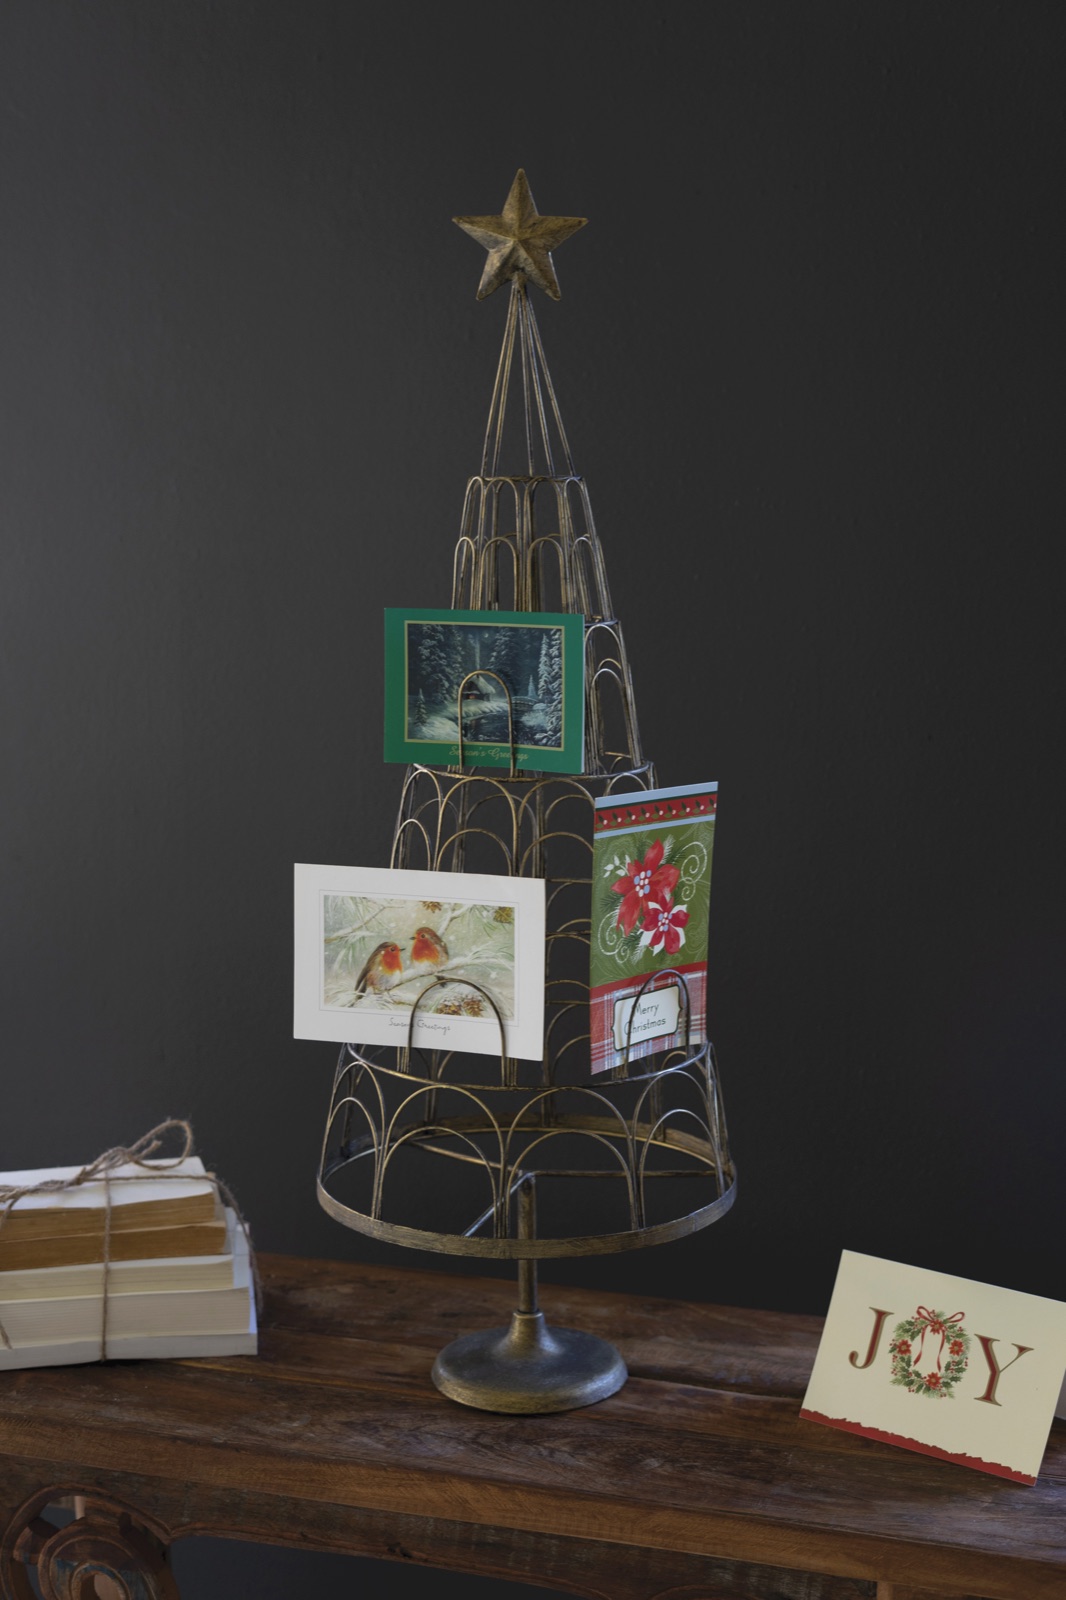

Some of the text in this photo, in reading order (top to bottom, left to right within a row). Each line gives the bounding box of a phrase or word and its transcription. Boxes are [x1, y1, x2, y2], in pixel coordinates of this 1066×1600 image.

[449, 745, 529, 761] Seson's Greengs
[848, 1305, 1035, 1407] JOY
